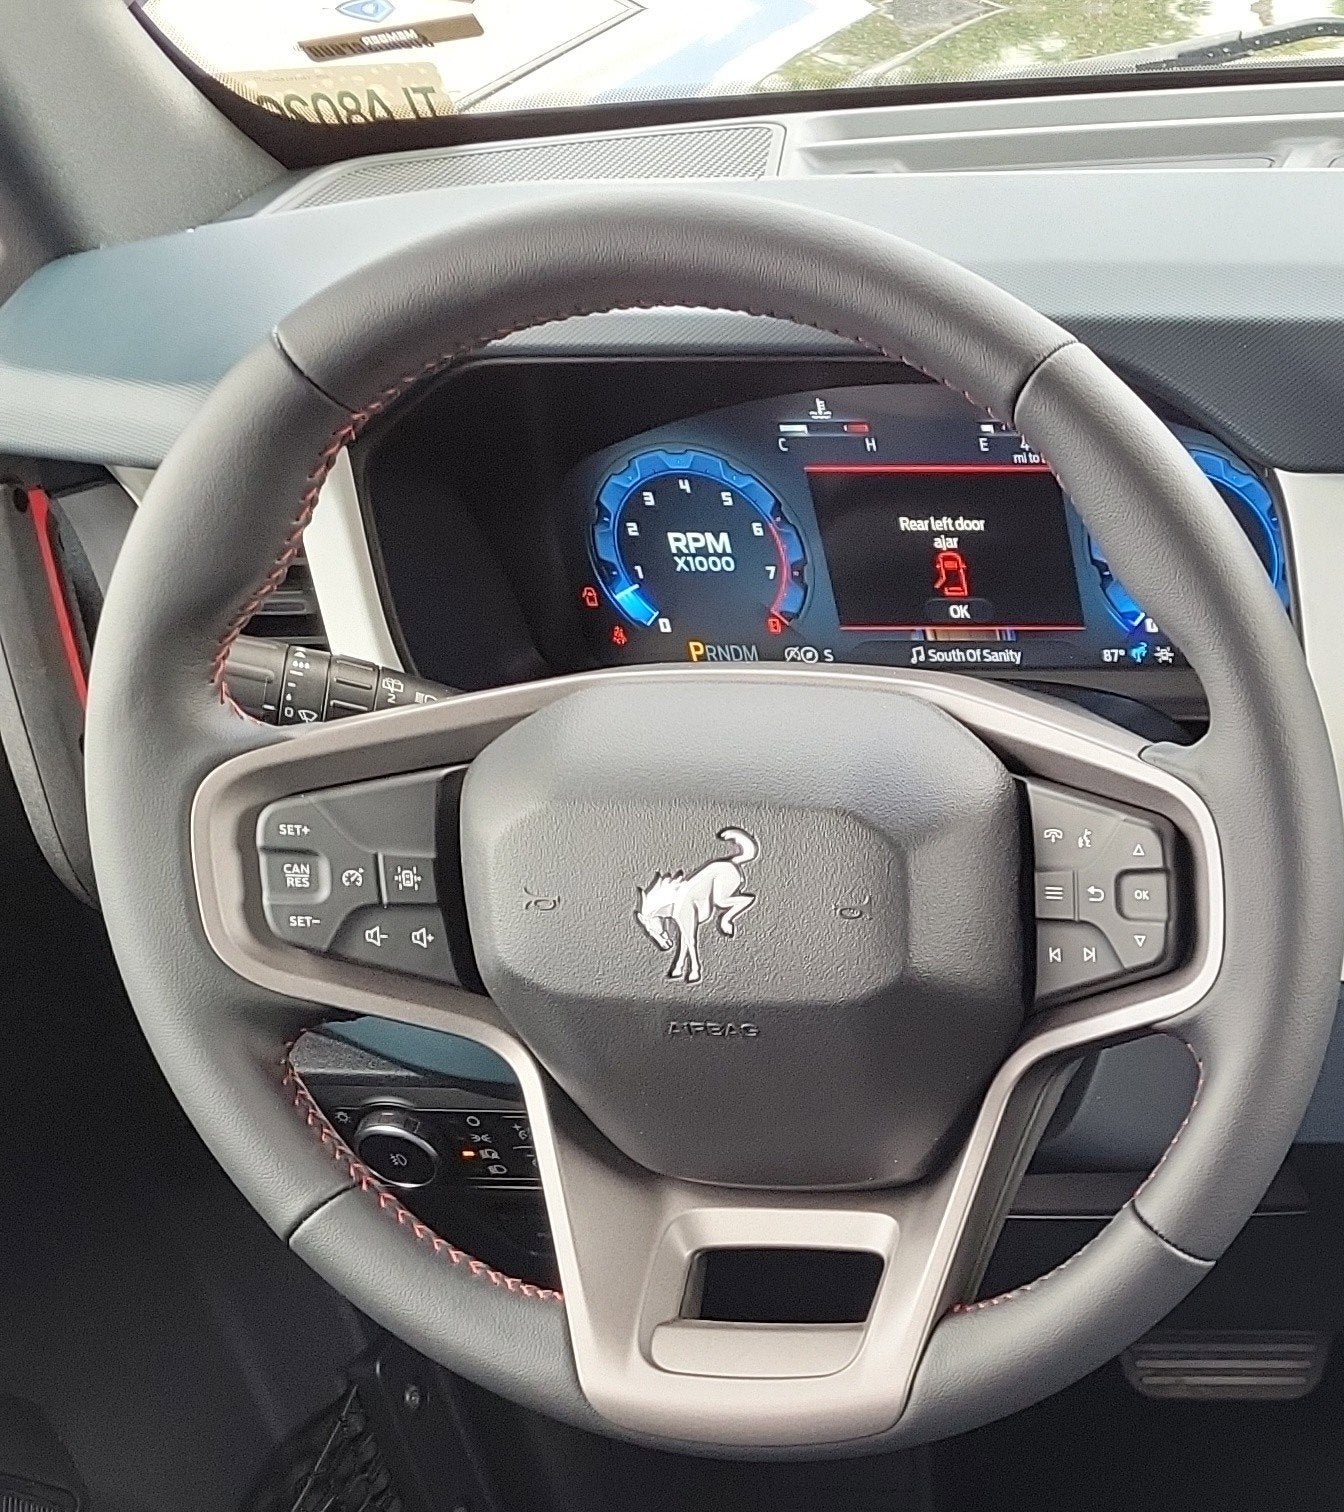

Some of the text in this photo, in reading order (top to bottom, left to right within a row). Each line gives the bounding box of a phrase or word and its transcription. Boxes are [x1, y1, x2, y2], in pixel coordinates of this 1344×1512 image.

[779, 437, 788, 452] C
[865, 437, 876, 452] H
[979, 437, 989, 452] E
[679, 479, 691, 494] 4
[643, 491, 655, 506] 3
[721, 491, 733, 506] 5
[626, 522, 639, 536] 2
[752, 522, 764, 536] 6
[900, 517, 985, 531] Rear left door
[667, 532, 732, 554] RPM
[933, 535, 959, 551] ajar
[673, 556, 735, 572] X1000
[634, 566, 644, 579] 1
[765, 566, 776, 579] 7
[949, 604, 970, 619] OK
[659, 618, 672, 633] 0
[928, 648, 1022, 665] South Of Sanity
[1103, 649, 1125, 662] 87°
[279, 824, 310, 836] SET+
[283, 863, 310, 875] CAN
[286, 877, 310, 888] RES
[1134, 889, 1150, 901] OK
[667, 1020, 760, 1037] AIRBAG
